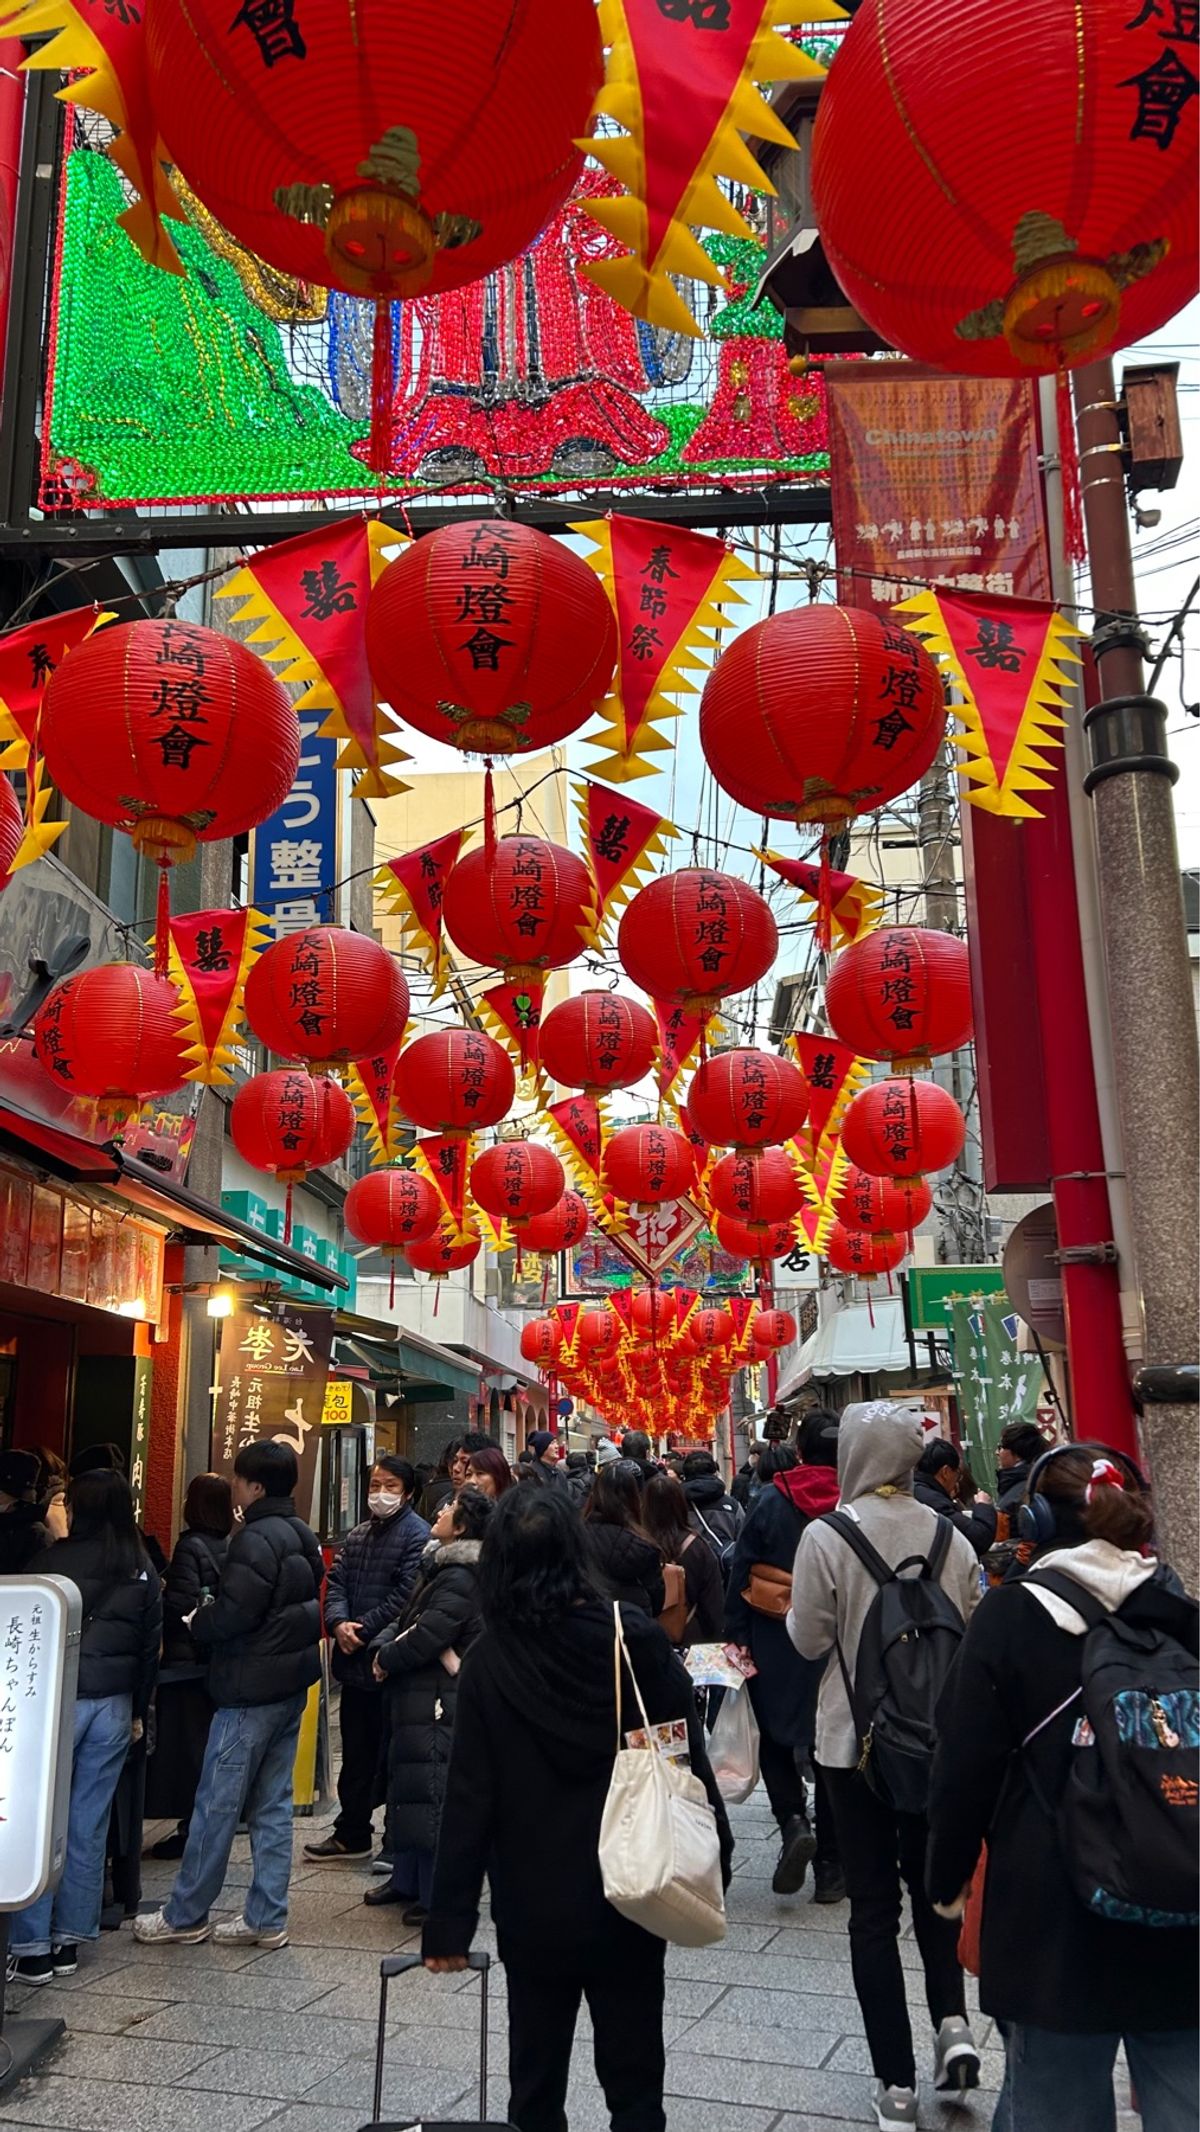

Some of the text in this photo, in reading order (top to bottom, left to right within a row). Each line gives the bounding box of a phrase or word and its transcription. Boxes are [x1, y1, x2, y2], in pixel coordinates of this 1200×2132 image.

[865, 427, 998, 446] Chinatown
[453, 523, 518, 672] 長崎燈會
[626, 545, 682, 661] 春節祭
[150, 622, 214, 770] 長崎燈會
[510, 842, 547, 938] 長崎燈會
[692, 874, 733, 973] 長崎燈會
[288, 934, 331, 1037] 長崎燈會
[880, 931, 923, 1030] 長崎燈會
[460, 1032, 488, 1109] 長崎燈會
[596, 996, 624, 1071] 長崎燈會
[277, 1075, 308, 1150] 長崎燈會
[742, 1055, 770, 1129] 長崎燈會
[882, 1086, 912, 1162] 長崎燈會
[503, 1148, 526, 1207] 長崎燈會
[647, 1130, 668, 1192] 長崎燈會
[854, 1169, 874, 1225] 崎燈會
[398, 1174, 422, 1233] 長崎燈會
[847, 1231, 865, 1264] 燈會
[25, 1603, 43, 1697] 元祖生からすみ
